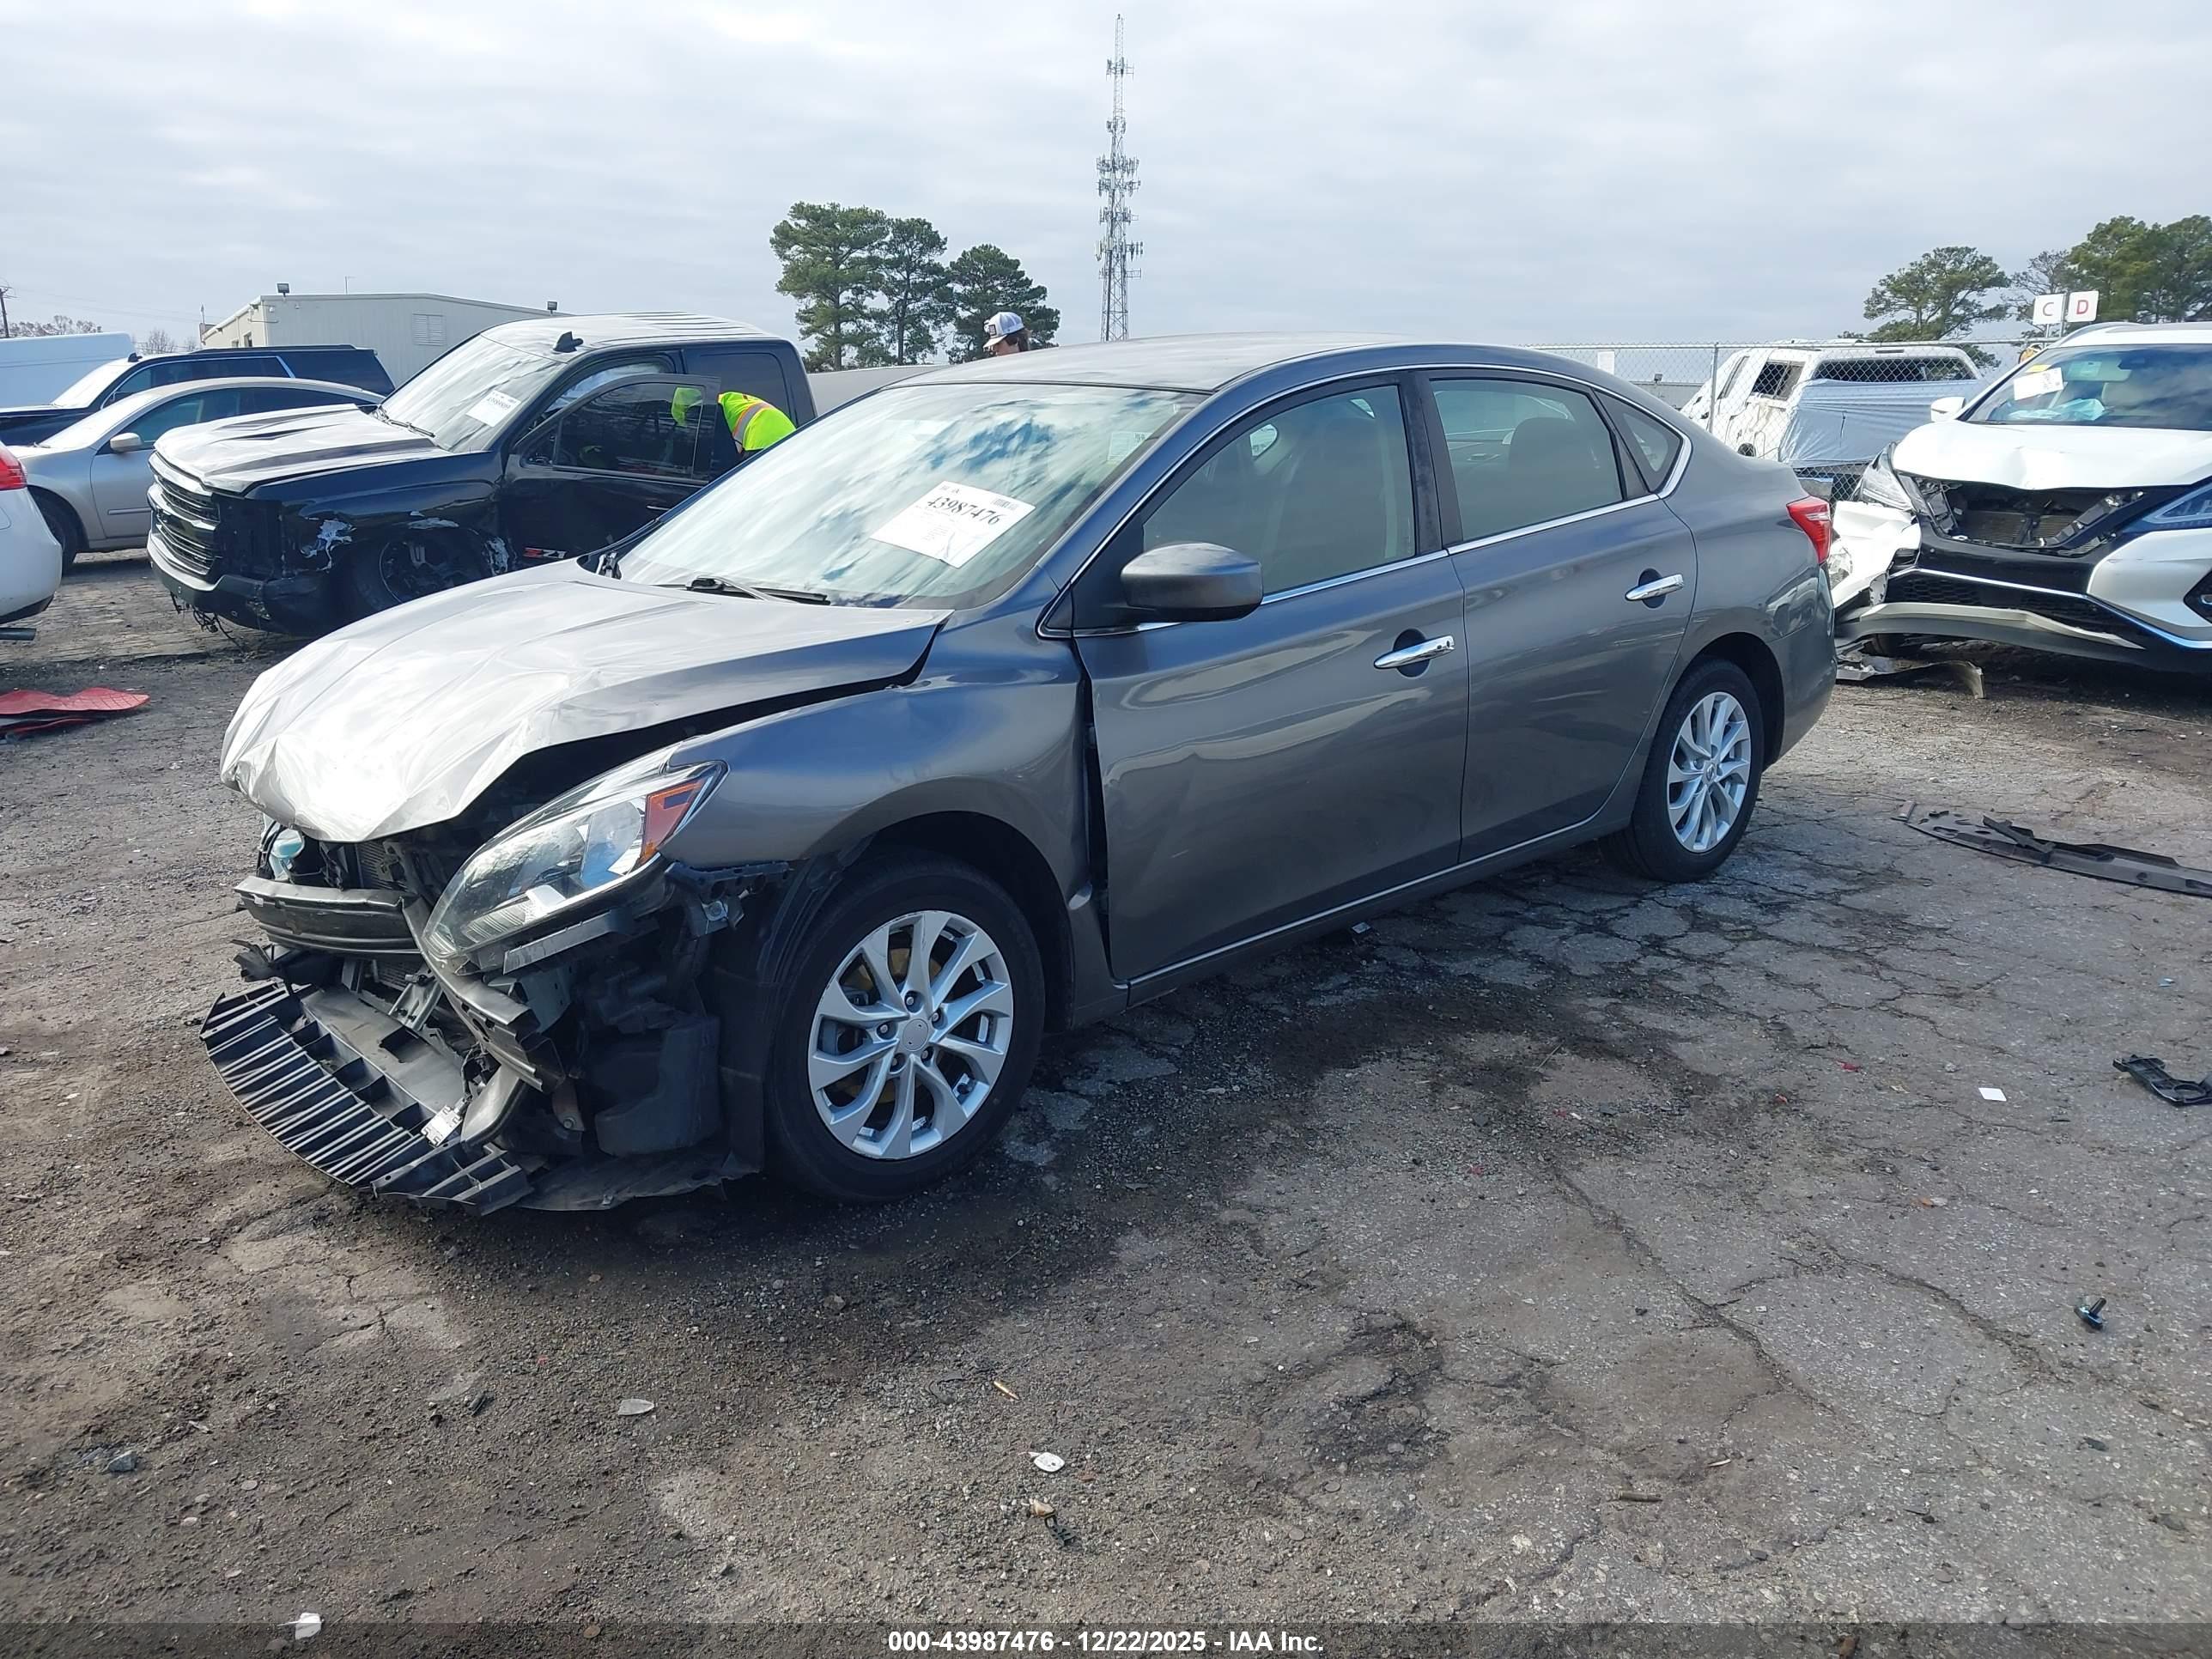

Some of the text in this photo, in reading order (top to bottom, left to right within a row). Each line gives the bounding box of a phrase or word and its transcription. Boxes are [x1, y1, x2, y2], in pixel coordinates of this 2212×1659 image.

[2043, 302, 2054, 316] C
[2076, 300, 2088, 314] D
[927, 496, 1003, 525] 43987476
